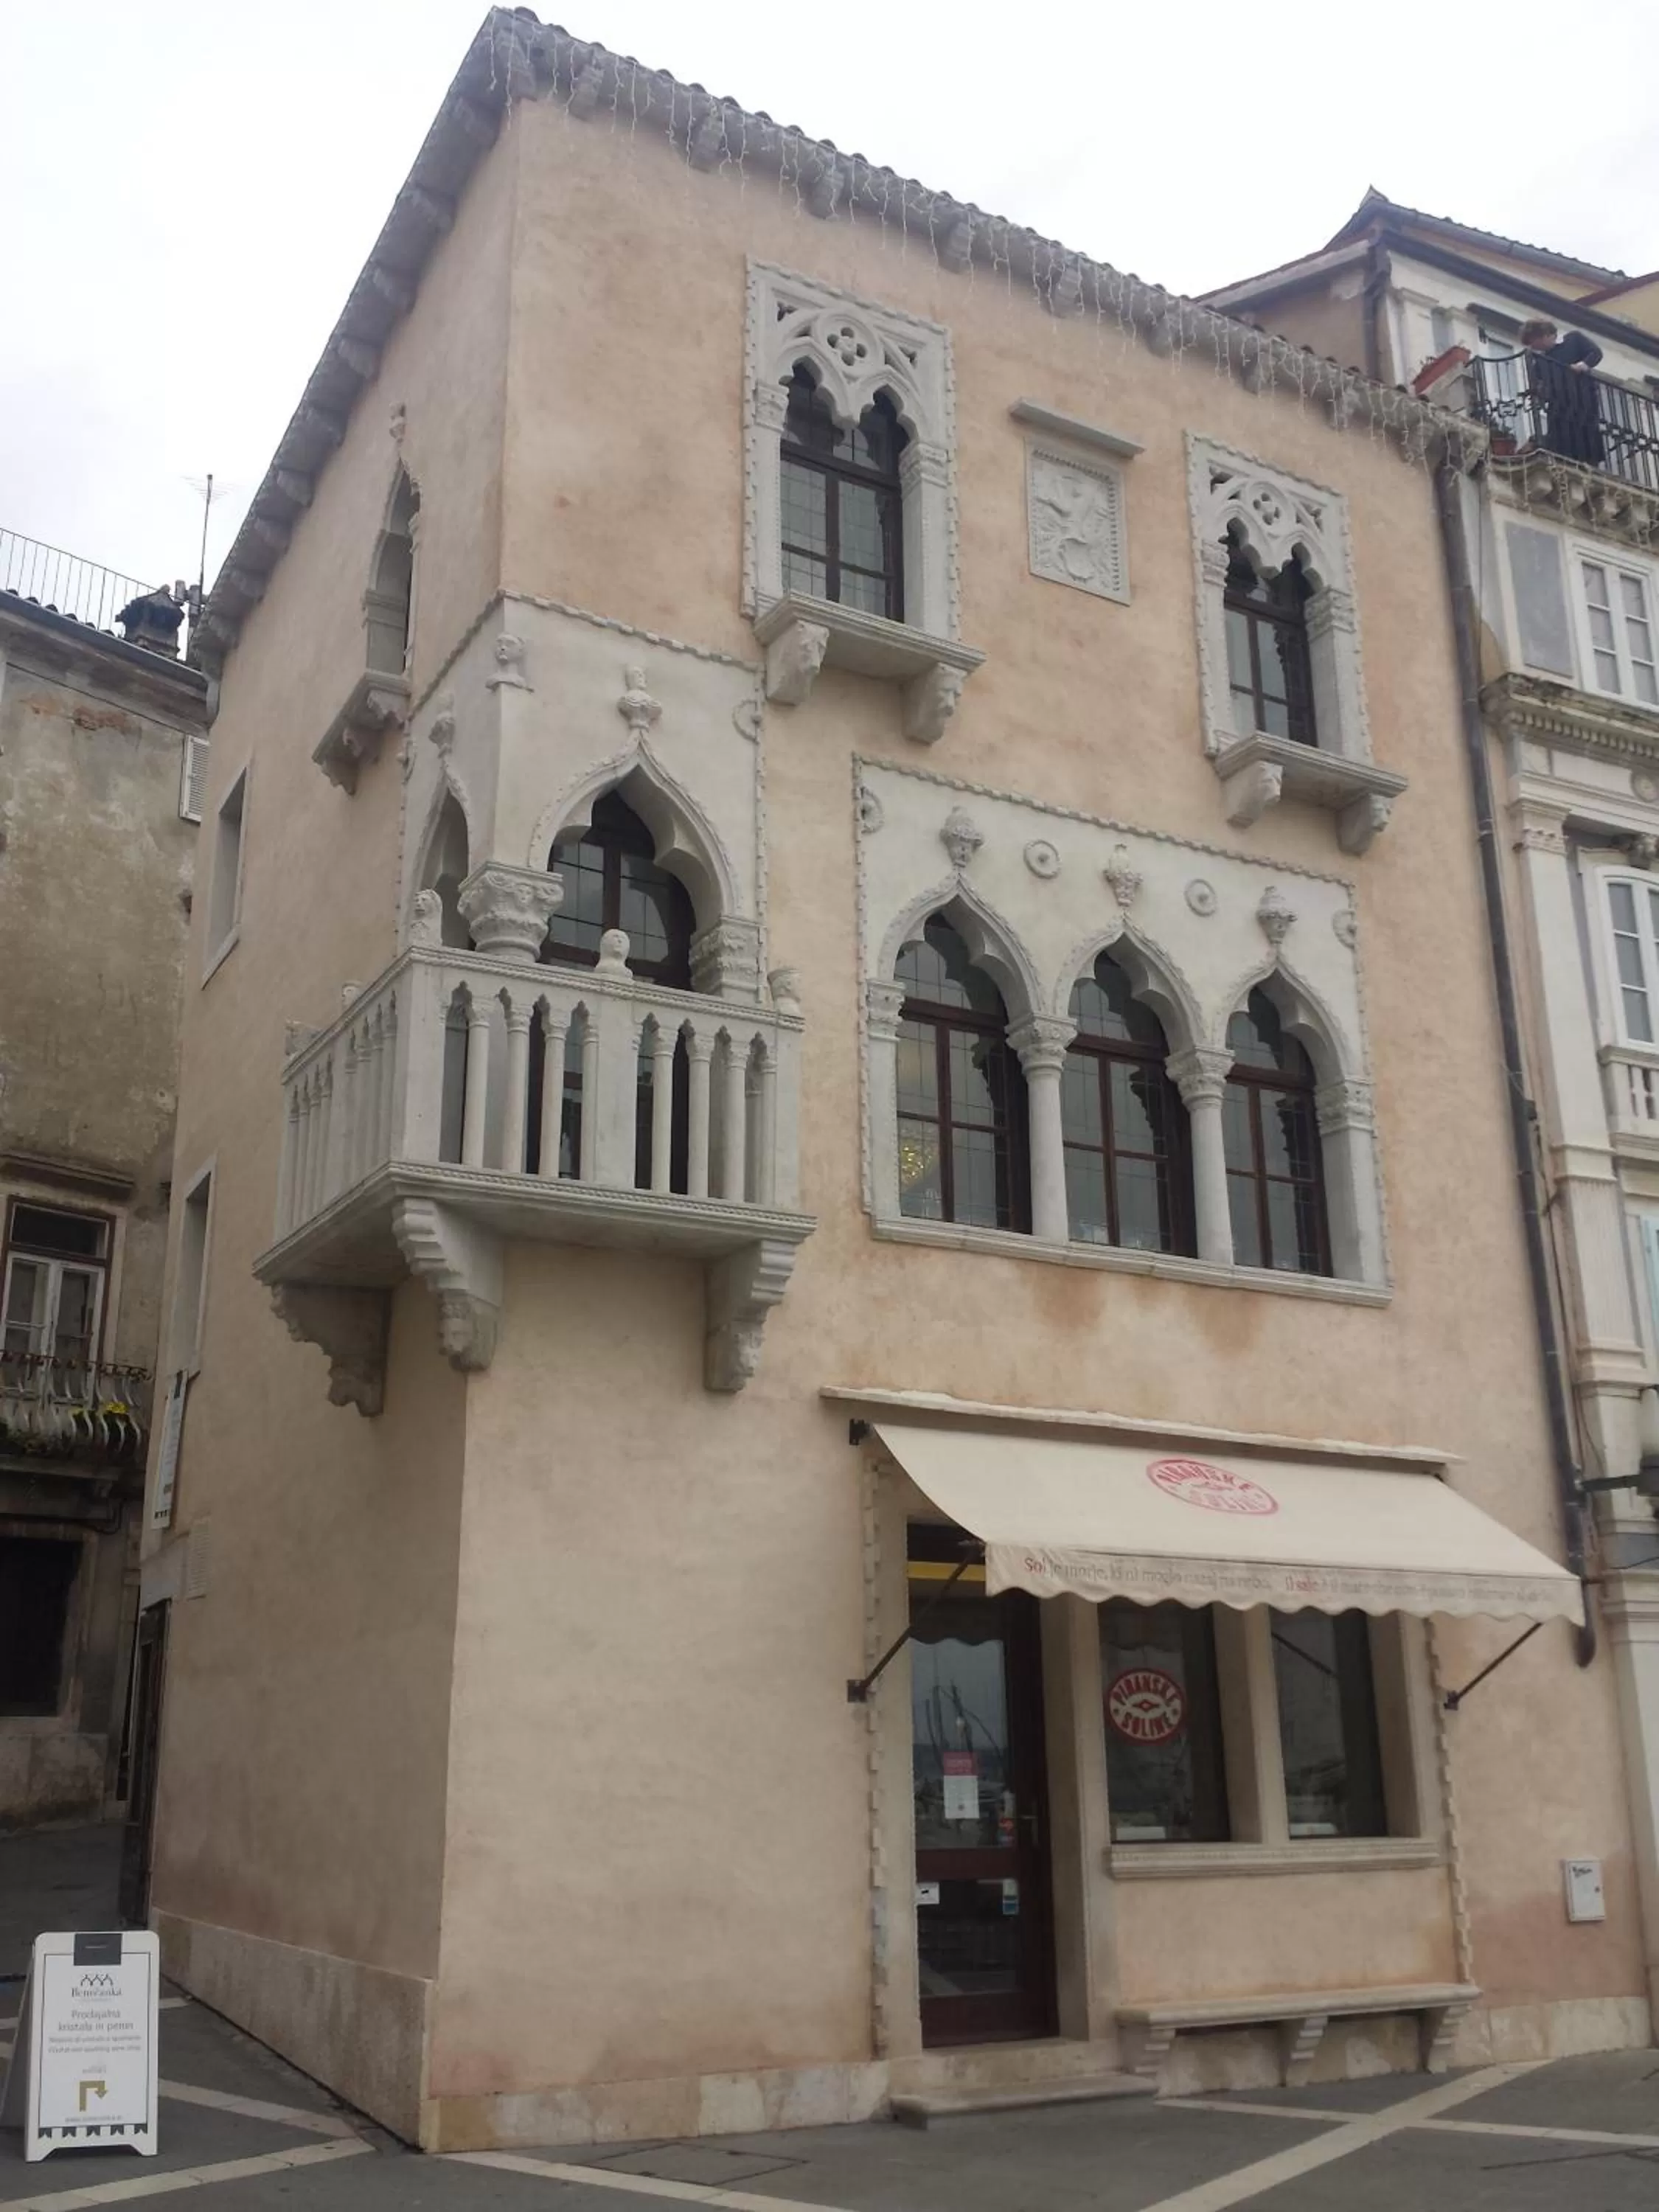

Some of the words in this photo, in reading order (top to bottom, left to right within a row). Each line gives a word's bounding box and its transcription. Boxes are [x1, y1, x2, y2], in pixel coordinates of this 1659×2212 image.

[1024, 1557, 1046, 1574] Sol
[1113, 1674, 1181, 1708] PIRANSKE
[1121, 1711, 1174, 1737] SOLINE
